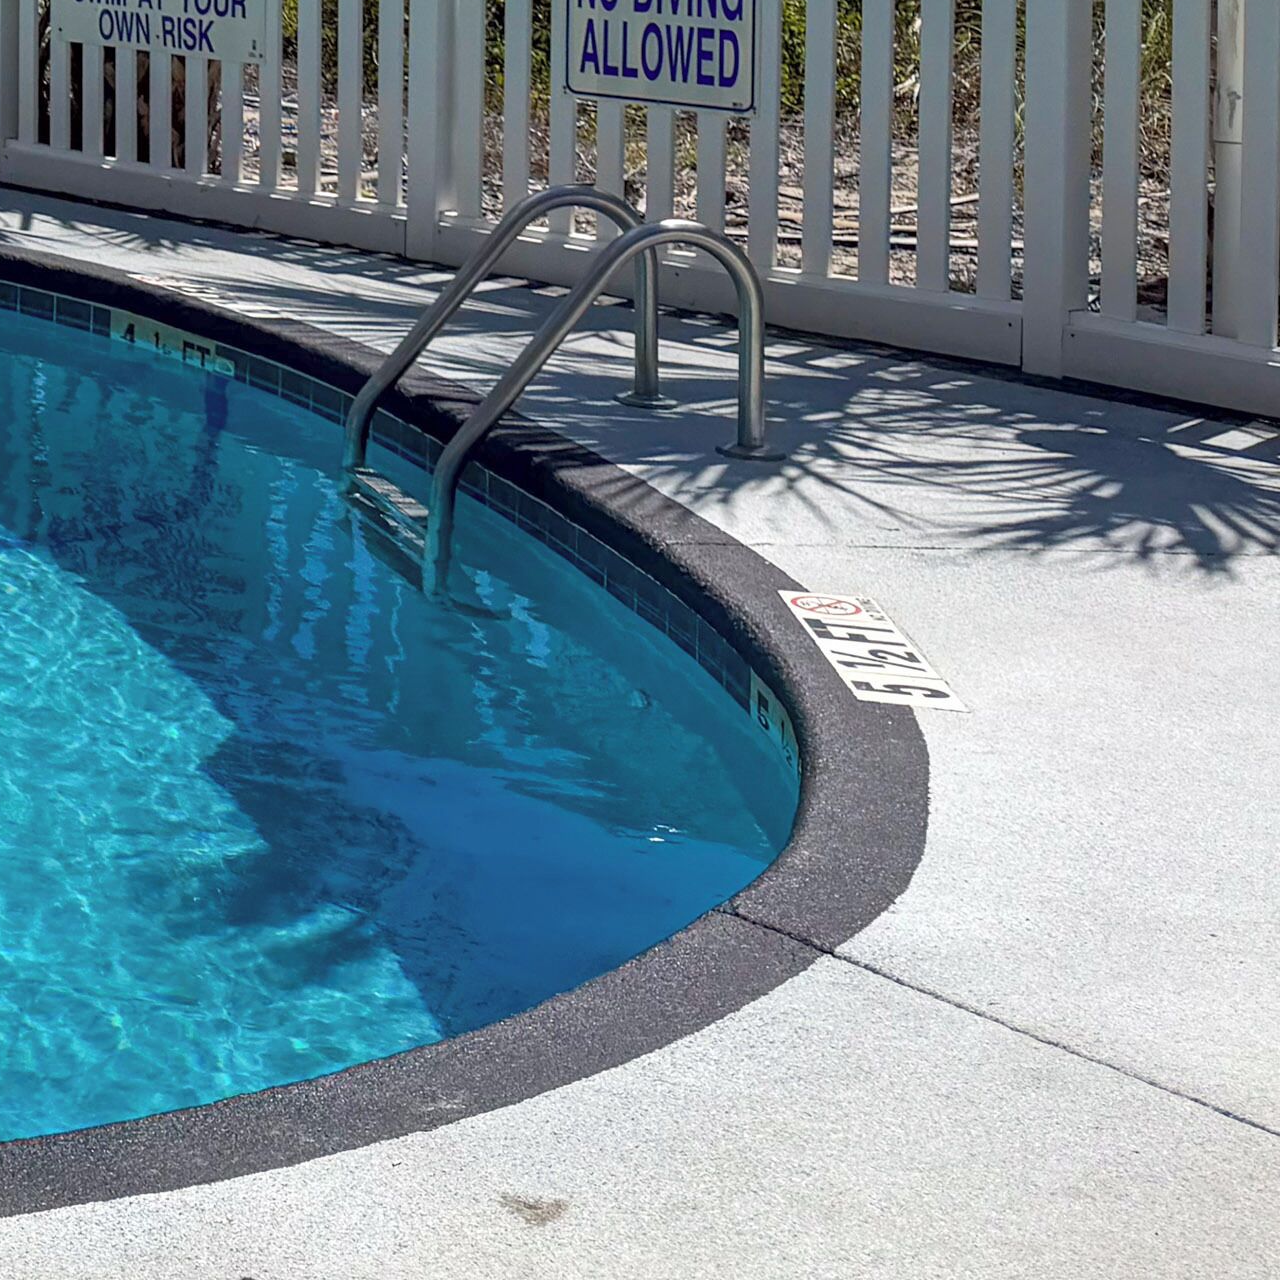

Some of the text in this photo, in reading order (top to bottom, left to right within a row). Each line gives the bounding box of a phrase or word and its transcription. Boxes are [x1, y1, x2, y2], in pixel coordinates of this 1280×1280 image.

[99, 8, 151, 45] OWN
[162, 16, 215, 53] RISK
[580, 18, 740, 89] ALLOWED
[803, 618, 907, 647] FT
[851, 679, 951, 699] 5
